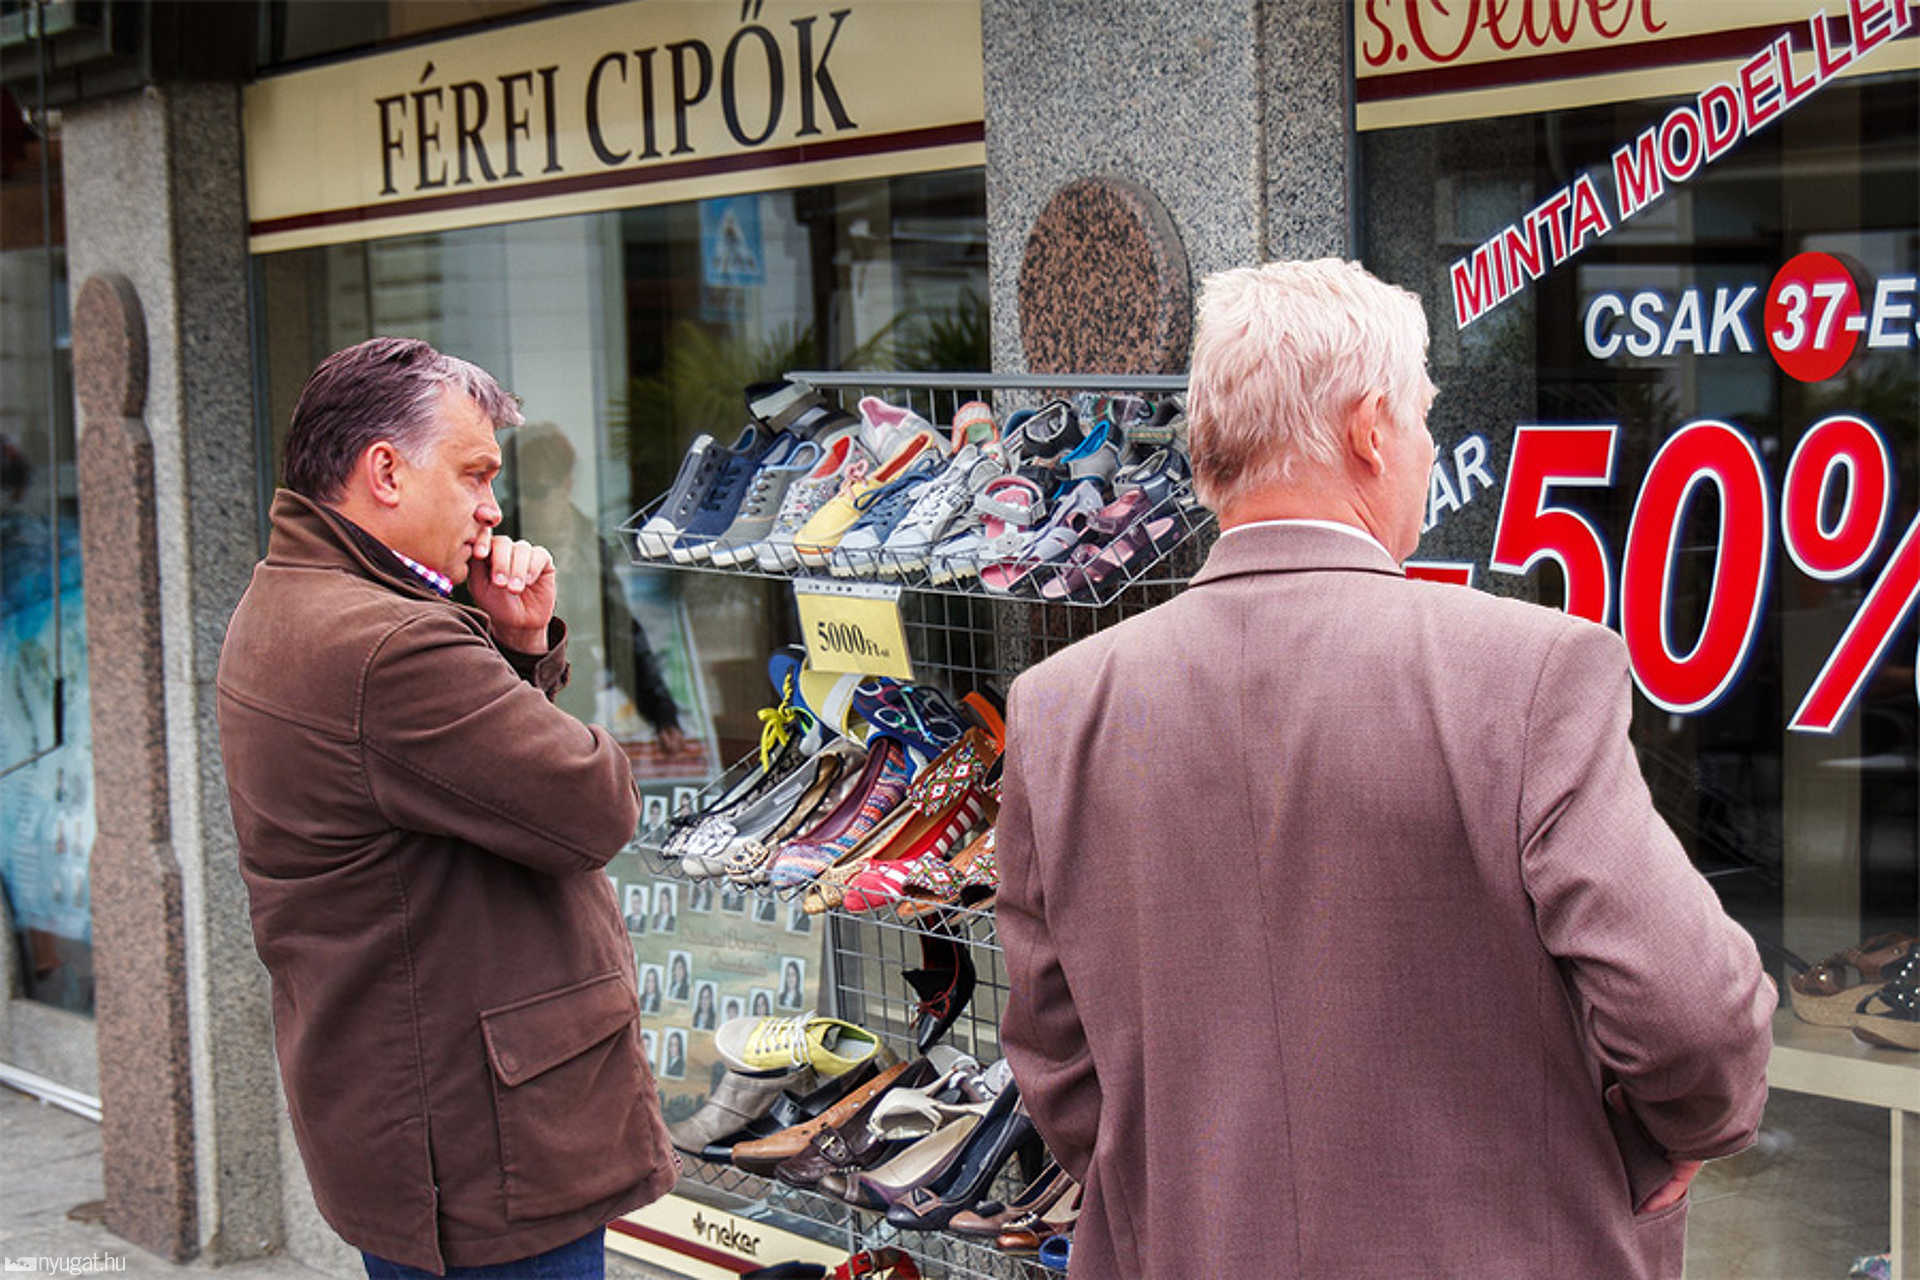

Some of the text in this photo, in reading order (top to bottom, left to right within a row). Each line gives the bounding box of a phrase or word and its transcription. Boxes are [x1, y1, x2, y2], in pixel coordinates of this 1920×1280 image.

[374, 0, 860, 197] FÉRFI CIPŐK
[1449, 173, 1612, 332] MINTA
[1584, 276, 1920, 360] CSAK 37-E
[1420, 434, 1495, 535] ÁR
